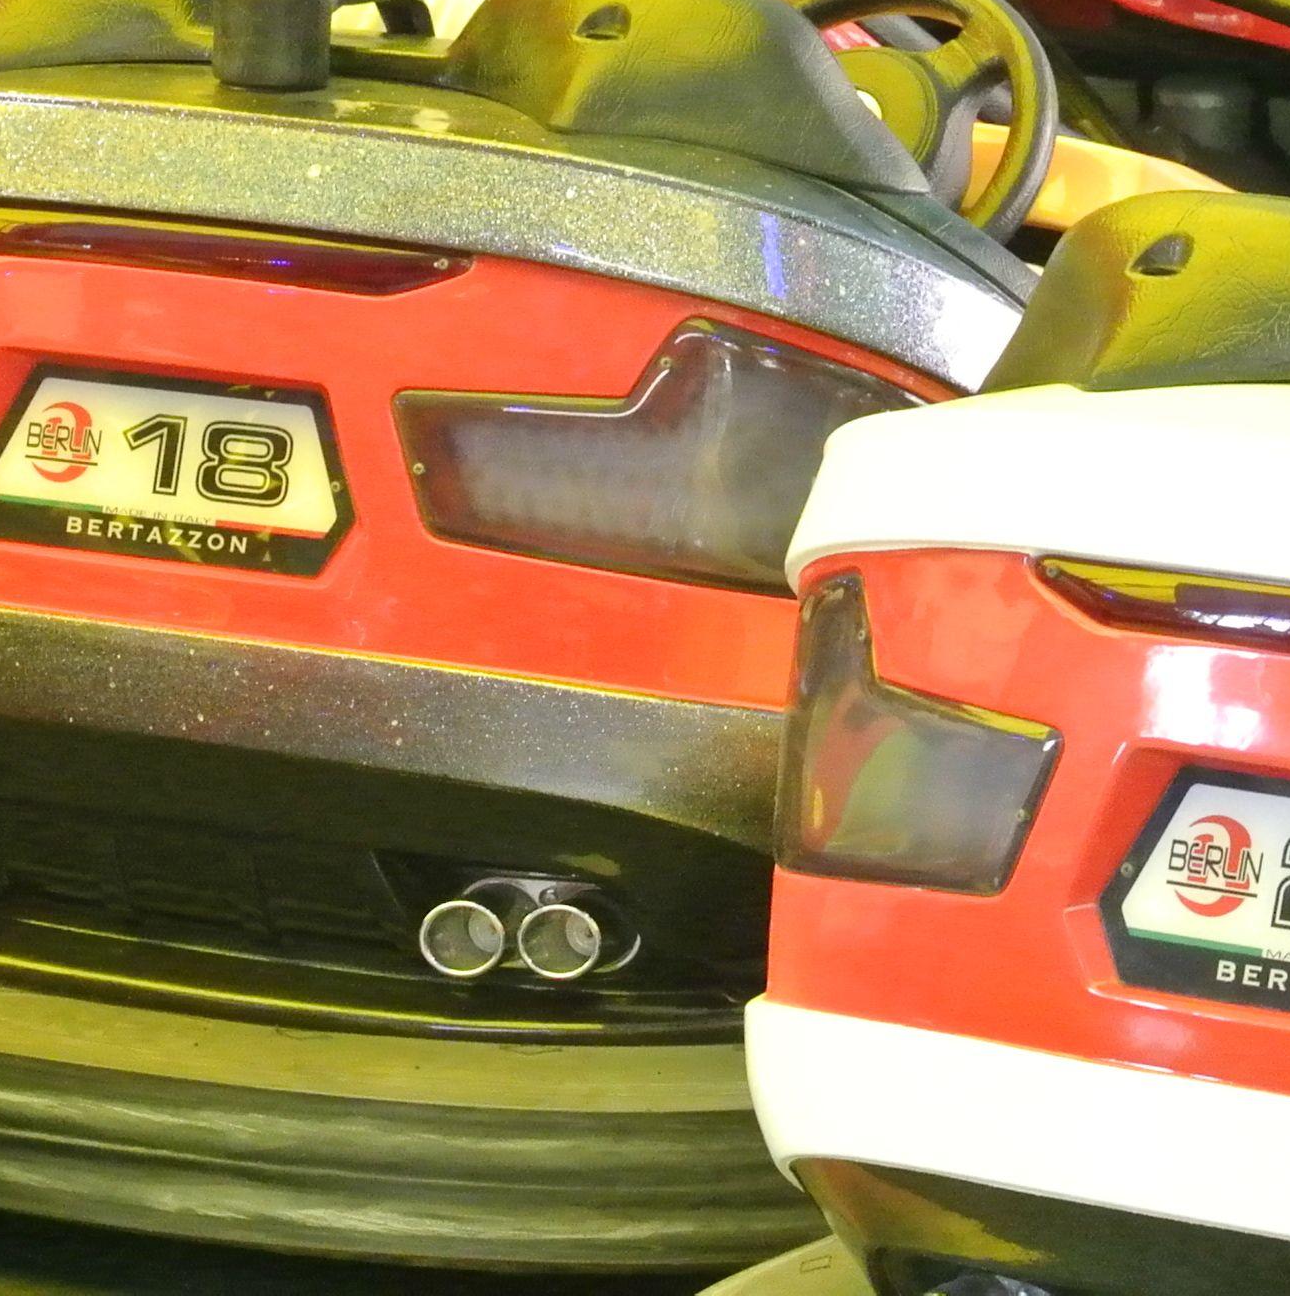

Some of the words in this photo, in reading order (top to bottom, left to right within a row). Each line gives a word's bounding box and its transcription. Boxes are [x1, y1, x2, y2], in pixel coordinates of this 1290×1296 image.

[26, 421, 102, 455] BERLIN
[122, 413, 294, 508] 18
[65, 515, 249, 554] BERTAZZON
[105, 505, 144, 518] MADE
[152, 511, 168, 520] IN
[174, 513, 212, 525] ITALY
[1168, 838, 1264, 885] BERLIN
